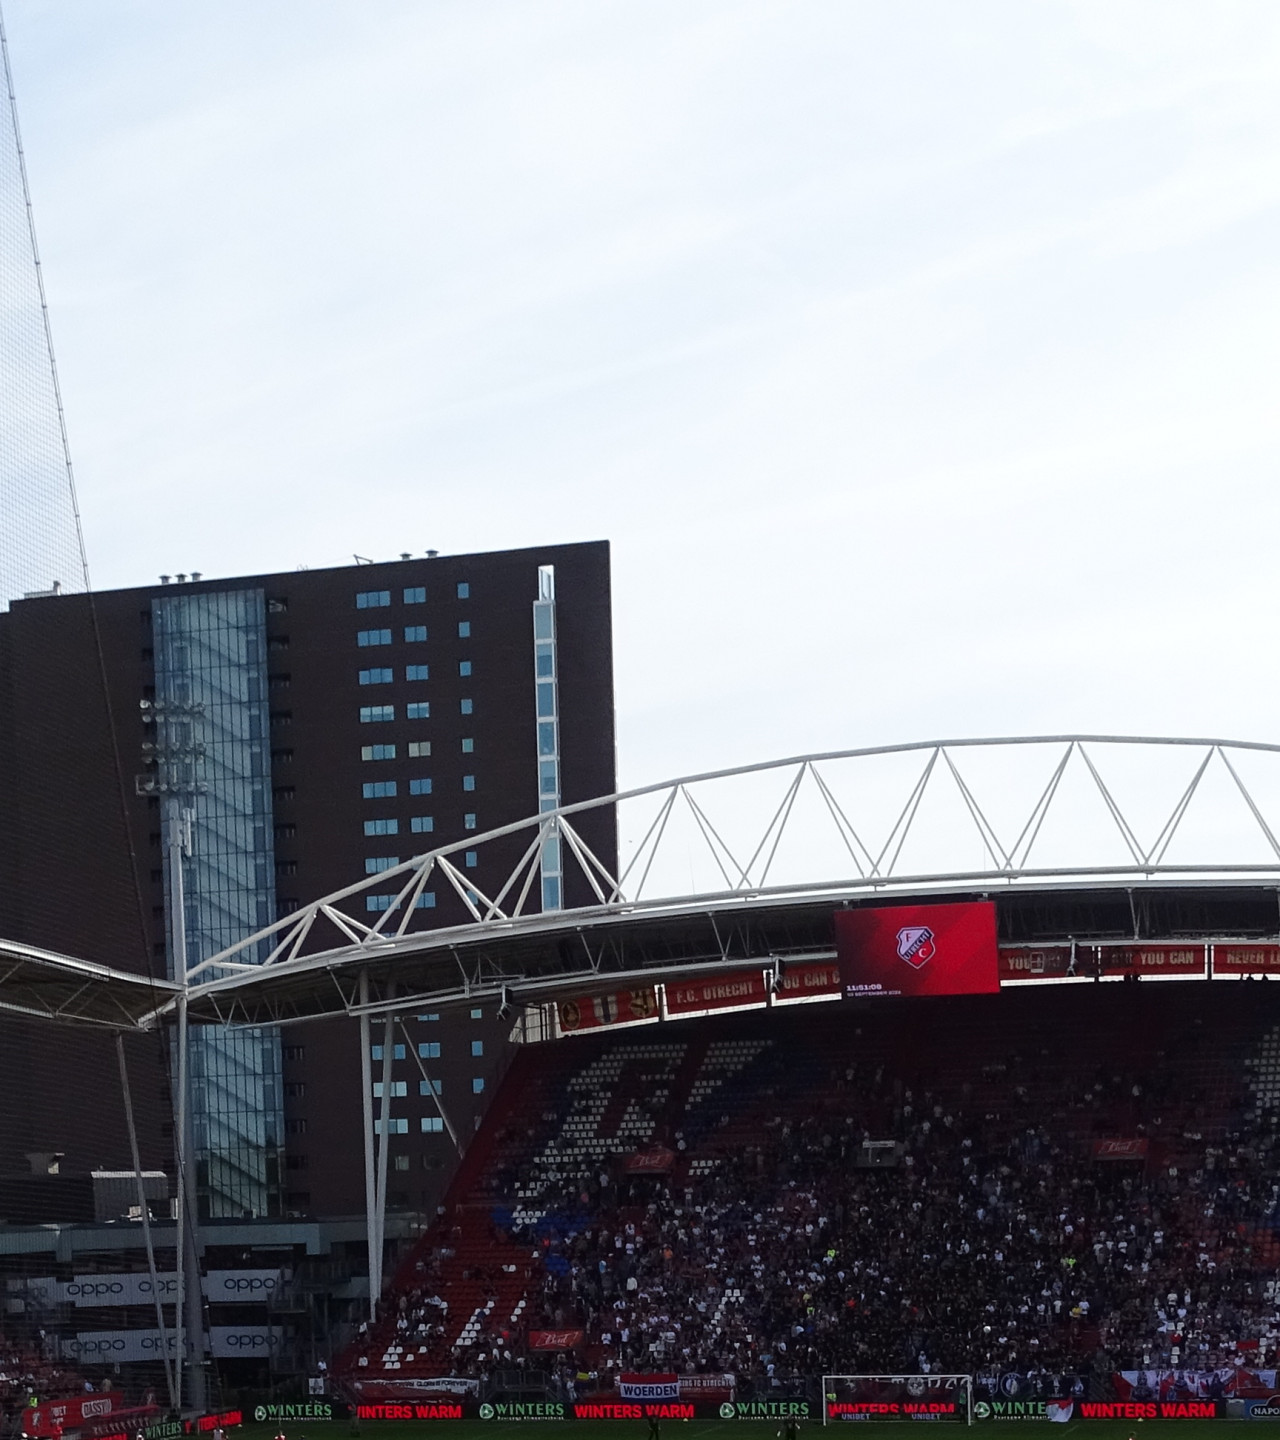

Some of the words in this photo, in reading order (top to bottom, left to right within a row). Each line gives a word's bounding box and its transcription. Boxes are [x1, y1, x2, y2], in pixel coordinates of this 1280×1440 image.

[905, 932, 912, 942] F
[904, 930, 931, 960] UTRECHT
[918, 947, 928, 958] C
[1139, 953, 1165, 965] YOU
[1169, 953, 1194, 965] CAN
[1226, 950, 1265, 965] NEVER
[804, 971, 828, 987] CAN
[702, 981, 754, 1001] UTRECHT
[67, 1281, 123, 1298] oppo
[224, 1277, 276, 1293] oppo
[70, 1338, 126, 1354] oppo
[226, 1334, 278, 1349] oppo
[544, 1332, 569, 1345] Bud
[622, 1383, 677, 1398] WOERDEN
[267, 1403, 332, 1417] WINTERS
[356, 1404, 412, 1418] INTERS
[415, 1404, 463, 1418] WARM
[495, 1402, 565, 1416] WINTERS
[573, 1404, 642, 1418] WINTERS
[645, 1404, 695, 1418] WARM
[736, 1402, 810, 1416] WINTERS
[992, 1401, 1047, 1415] WINTE
[1080, 1402, 1157, 1418] WINTERS
[1160, 1402, 1217, 1418] WARM
[841, 1412, 871, 1420] UNIBET
[911, 1412, 941, 1420] UNIBET
[144, 1420, 182, 1438] WINTERS
